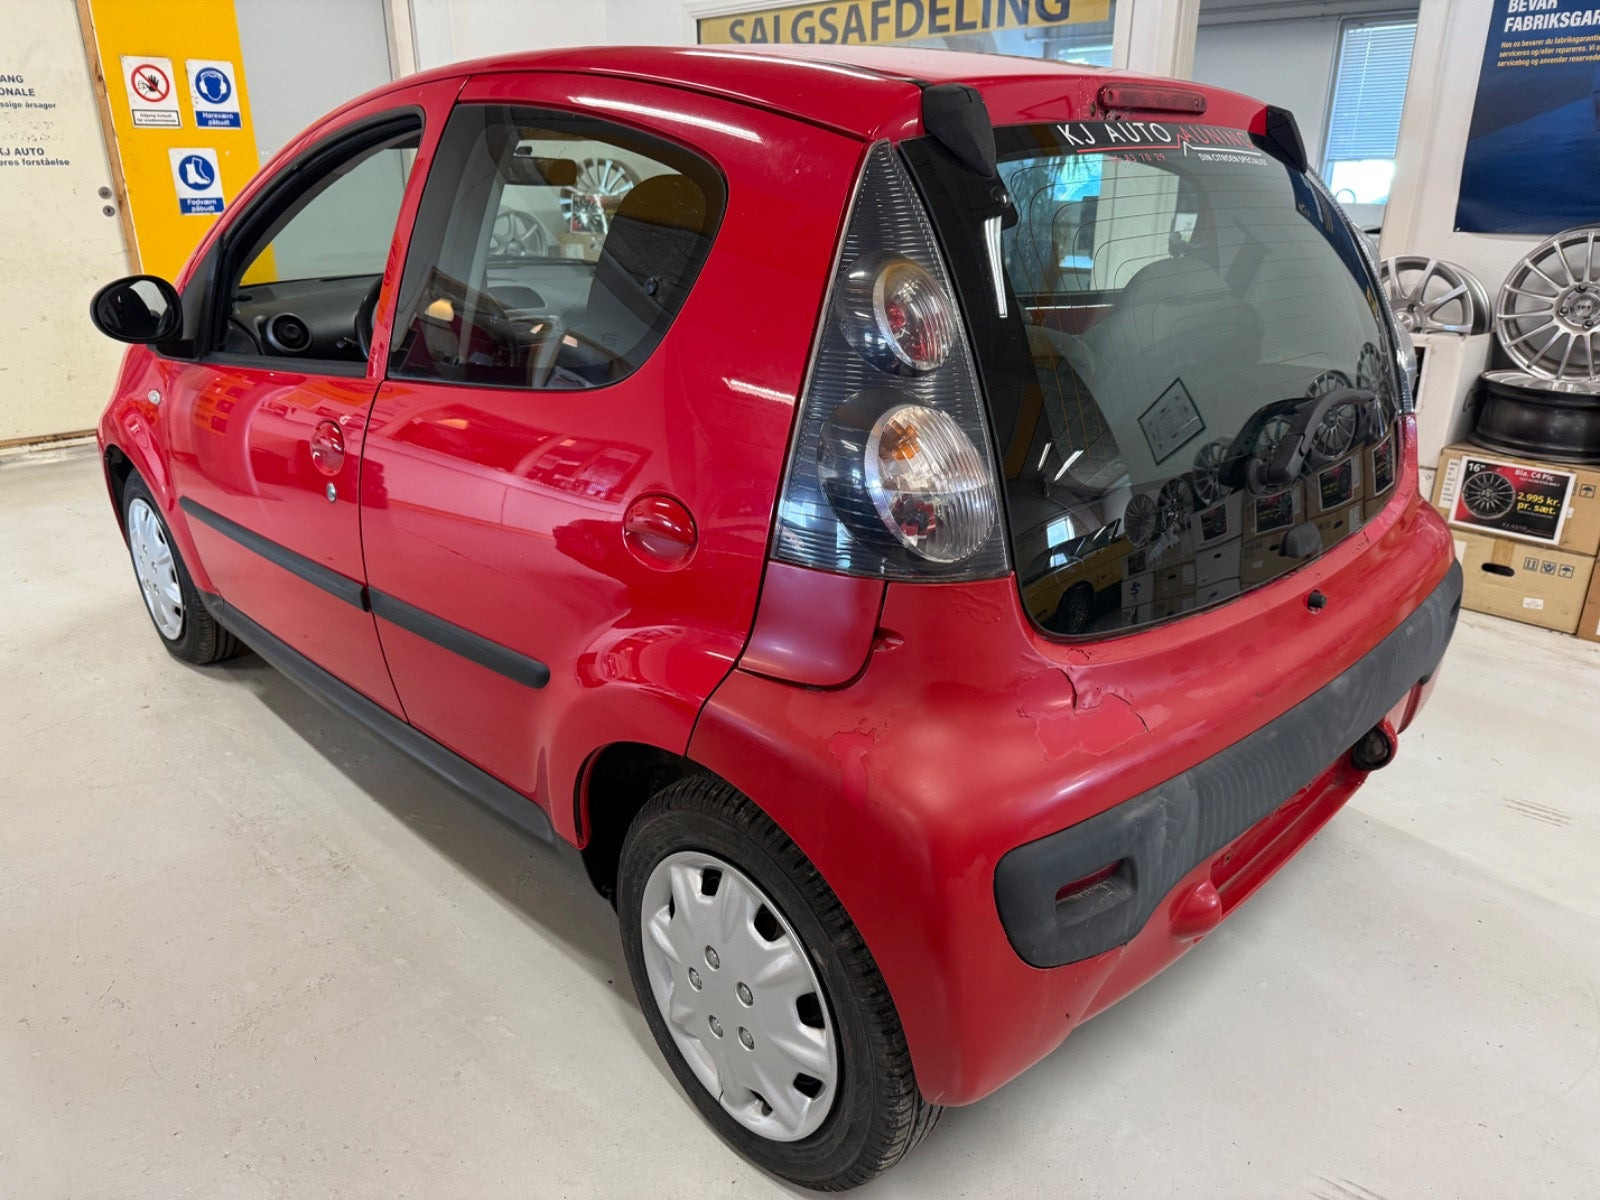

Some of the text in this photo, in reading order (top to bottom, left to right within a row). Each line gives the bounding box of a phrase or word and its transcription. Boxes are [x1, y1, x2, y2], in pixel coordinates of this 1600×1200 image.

[1508, 0, 1558, 13] BEVAR
[729, 0, 1071, 44] SALGSAFDELING
[1497, 58, 1530, 67] servicebog
[1057, 123, 1096, 146] KJ
[1104, 122, 1172, 143] AUTO
[14, 147, 45, 156] AUTO
[1517, 491, 1561, 507] 2.995 kr.
[1516, 502, 1532, 511] pr.
